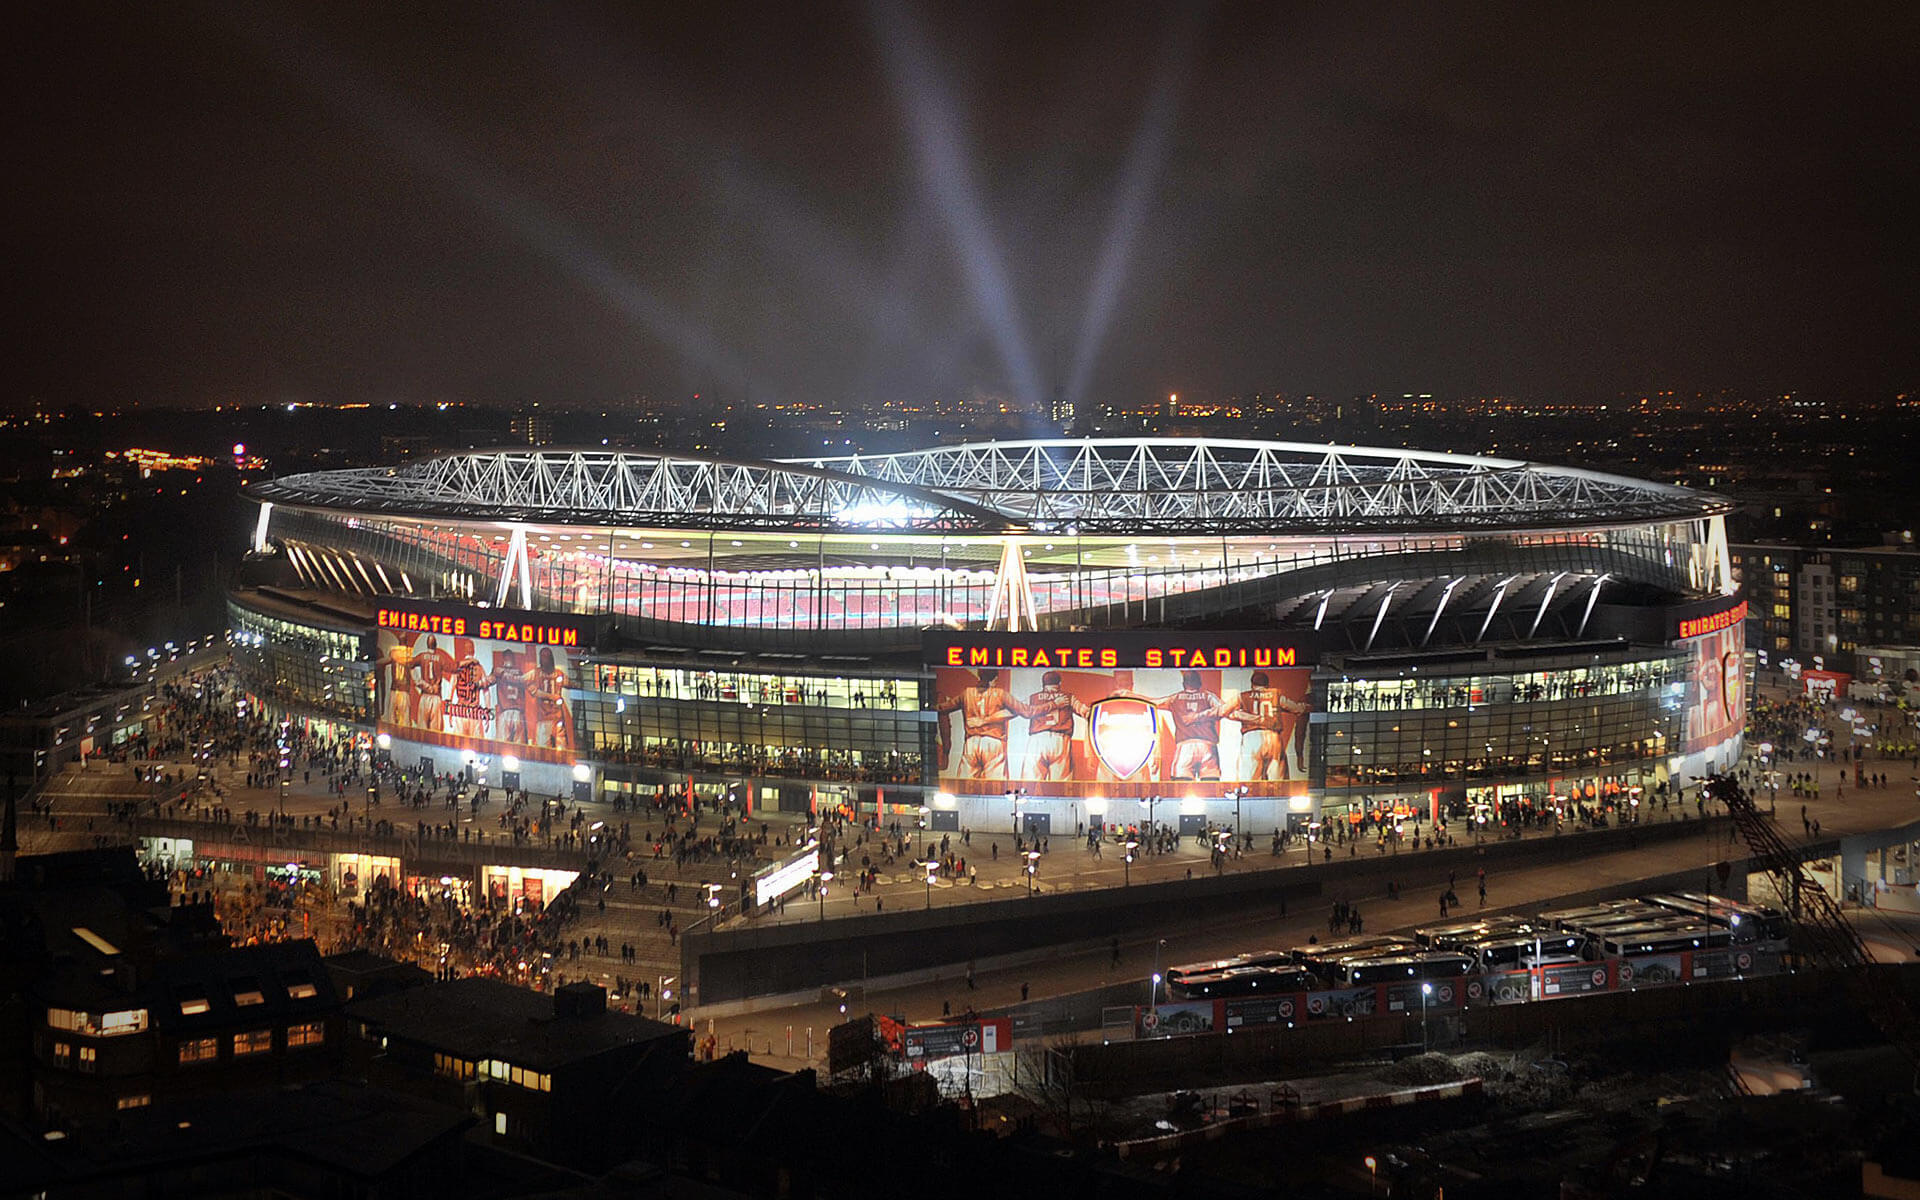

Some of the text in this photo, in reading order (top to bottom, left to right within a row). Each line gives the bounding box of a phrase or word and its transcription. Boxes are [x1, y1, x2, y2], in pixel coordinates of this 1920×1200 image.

[378, 610, 577, 646] EMIRATES STADIUM
[1680, 609, 1730, 638] EMIRATES
[947, 646, 1296, 667] EMIRATES STADIUM
